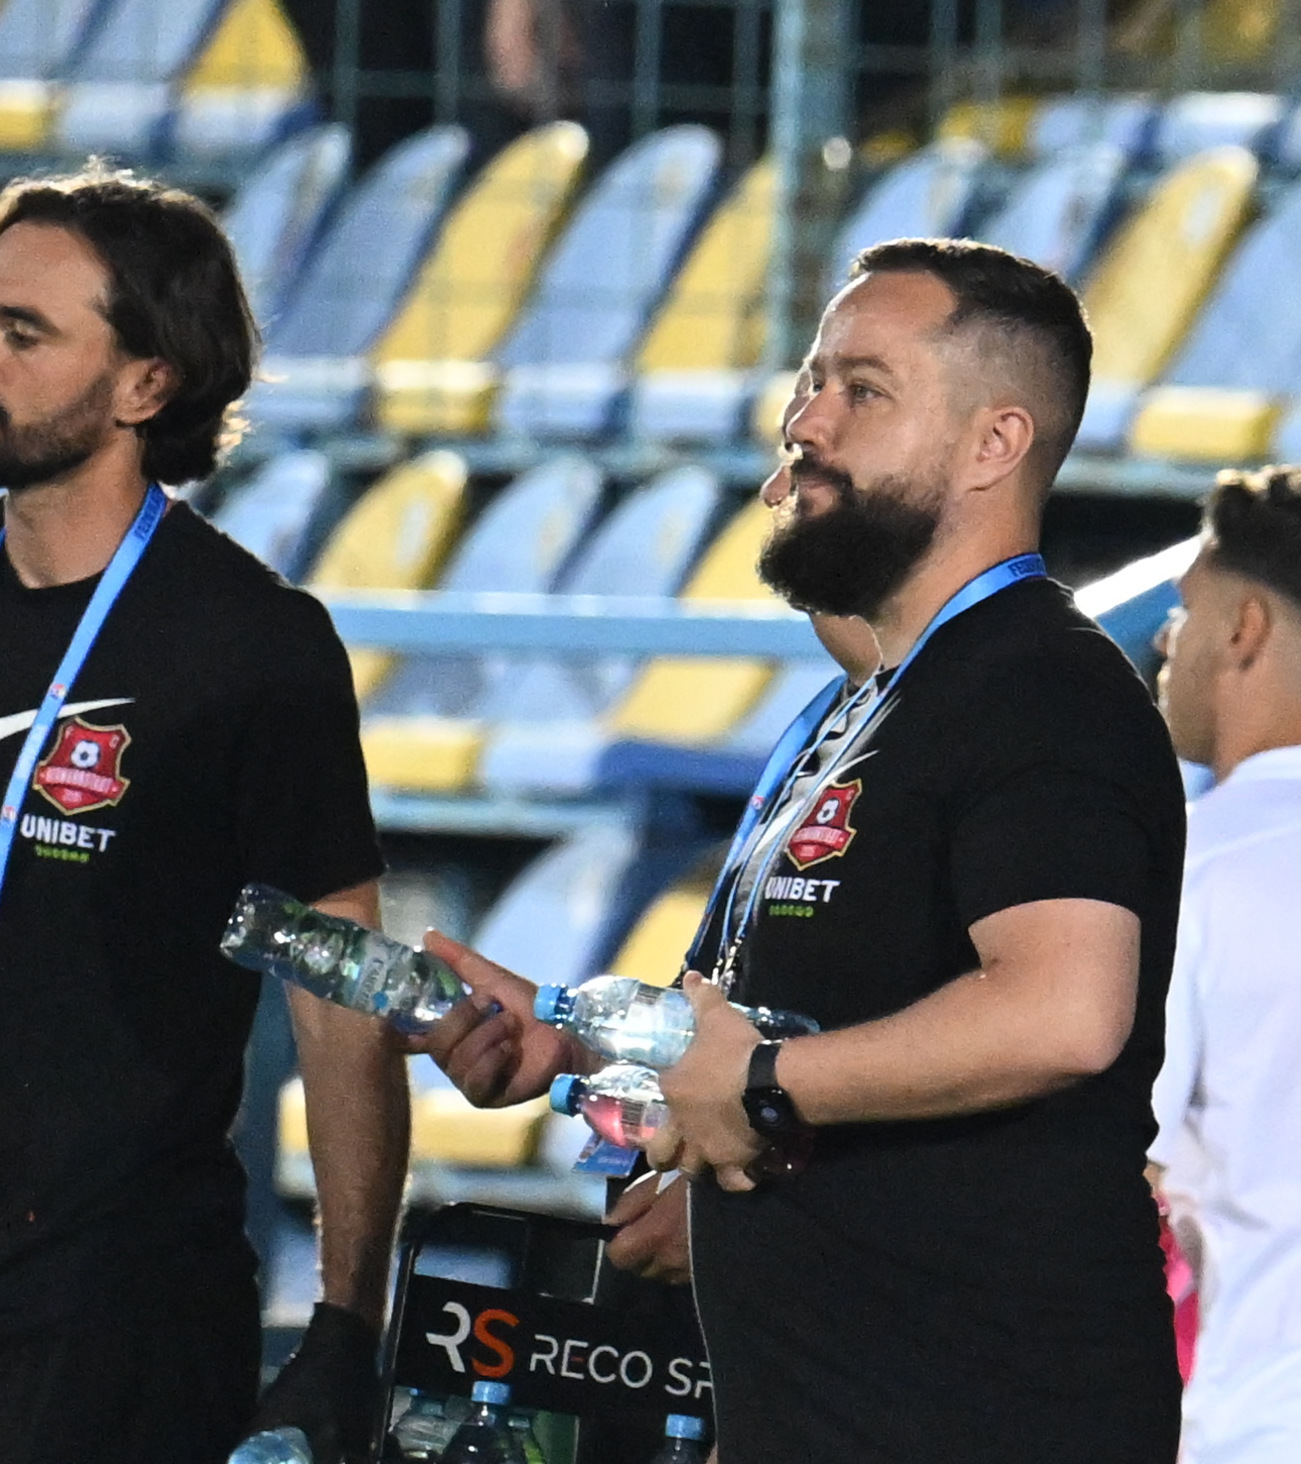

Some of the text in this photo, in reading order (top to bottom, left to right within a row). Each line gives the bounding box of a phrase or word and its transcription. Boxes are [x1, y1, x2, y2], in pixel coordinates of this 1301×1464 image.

[20, 813, 117, 853] UNIBET
[425, 1300, 521, 1378] RS
[528, 1333, 654, 1389] RECO
